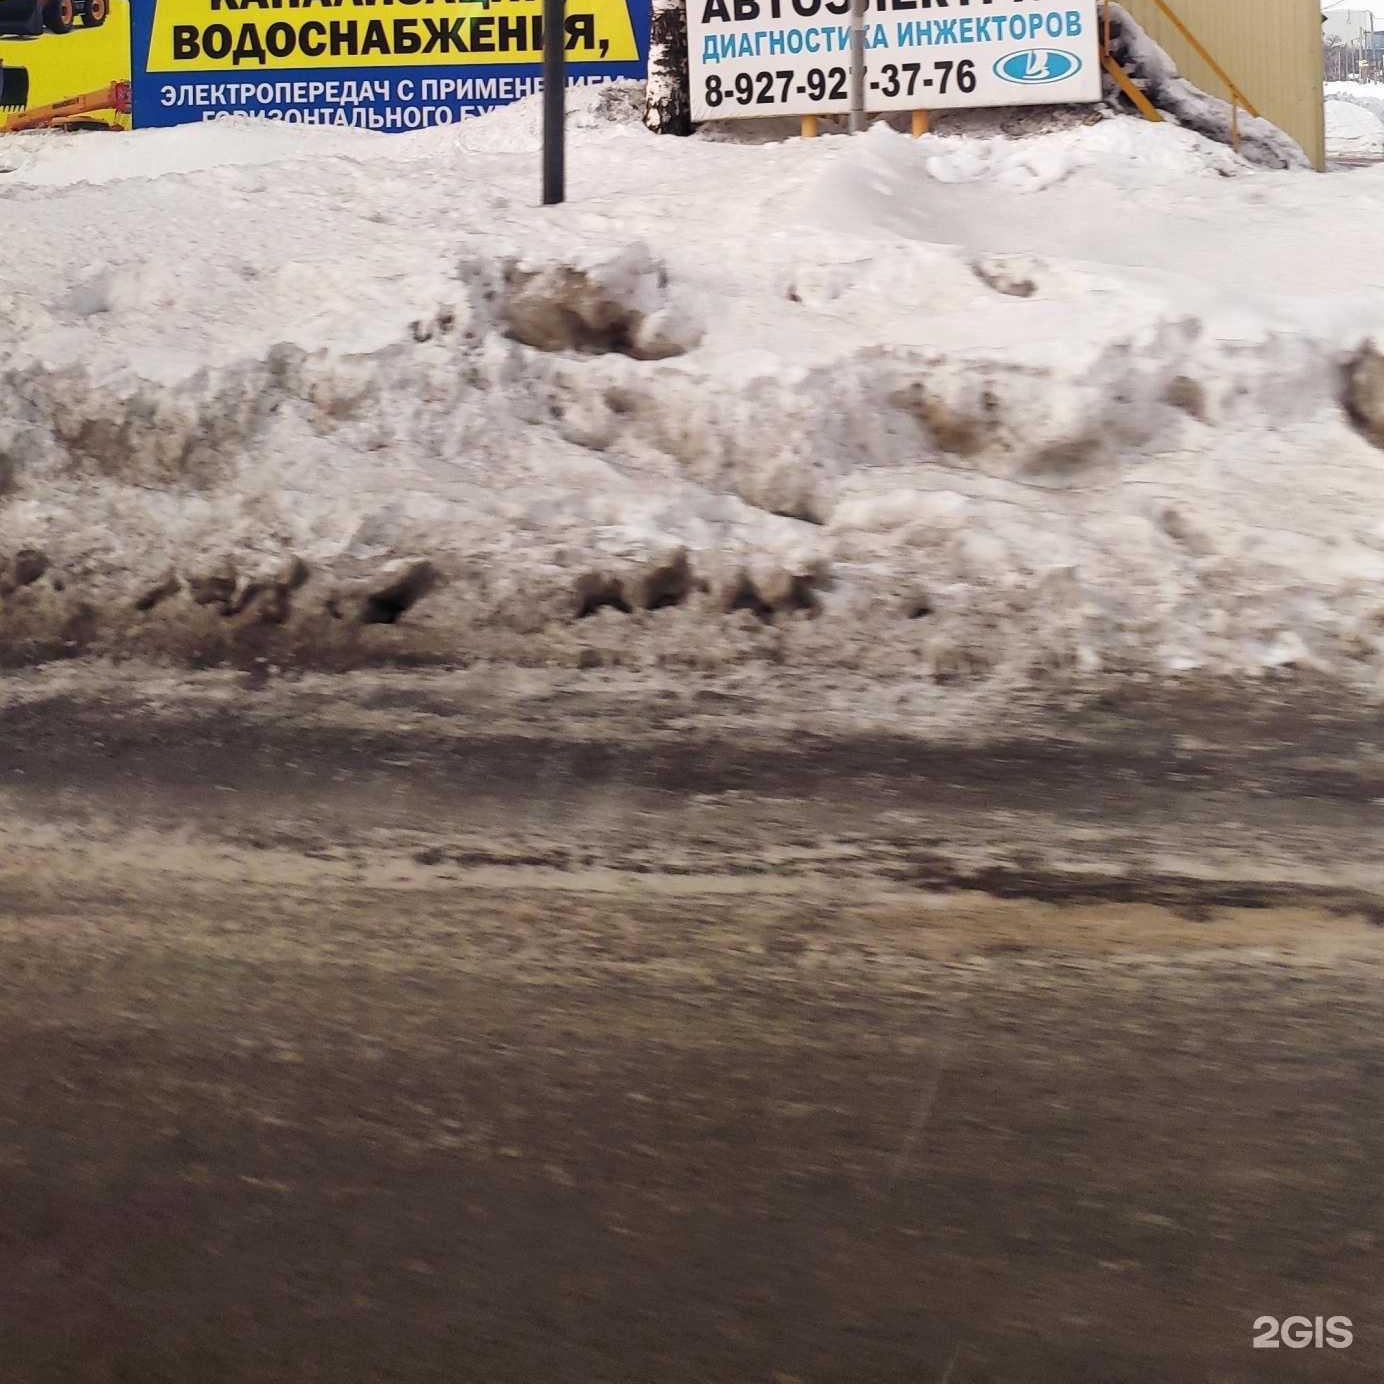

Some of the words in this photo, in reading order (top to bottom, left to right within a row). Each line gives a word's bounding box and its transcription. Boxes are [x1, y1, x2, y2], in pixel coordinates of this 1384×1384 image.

[898, 10, 1082, 48] ИНЖЕКТОРОВ
[160, 80, 390, 106] ЭЛЕКТРОПЕРЕДАЧ
[397, 79, 415, 102] С
